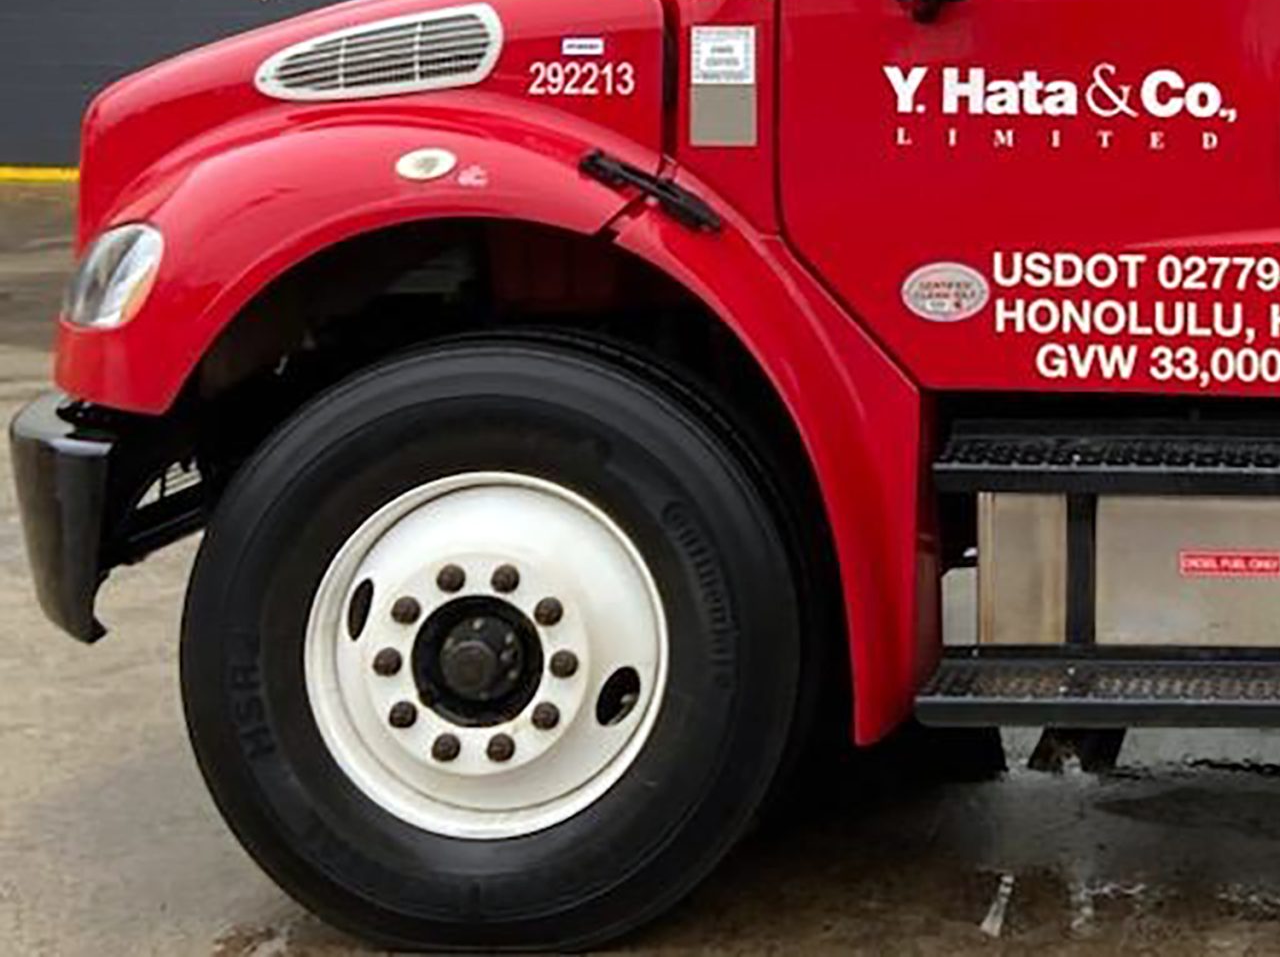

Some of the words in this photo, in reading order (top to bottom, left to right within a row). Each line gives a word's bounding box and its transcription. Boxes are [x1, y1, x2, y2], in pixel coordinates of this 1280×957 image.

[528, 61, 635, 95] 292213
[883, 66, 927, 113] Y.
[896, 127, 1218, 150] LIMITED
[993, 251, 1146, 289] USDOT
[995, 298, 1256, 344] HONOLULU,
[1035, 343, 1138, 379] GVW
